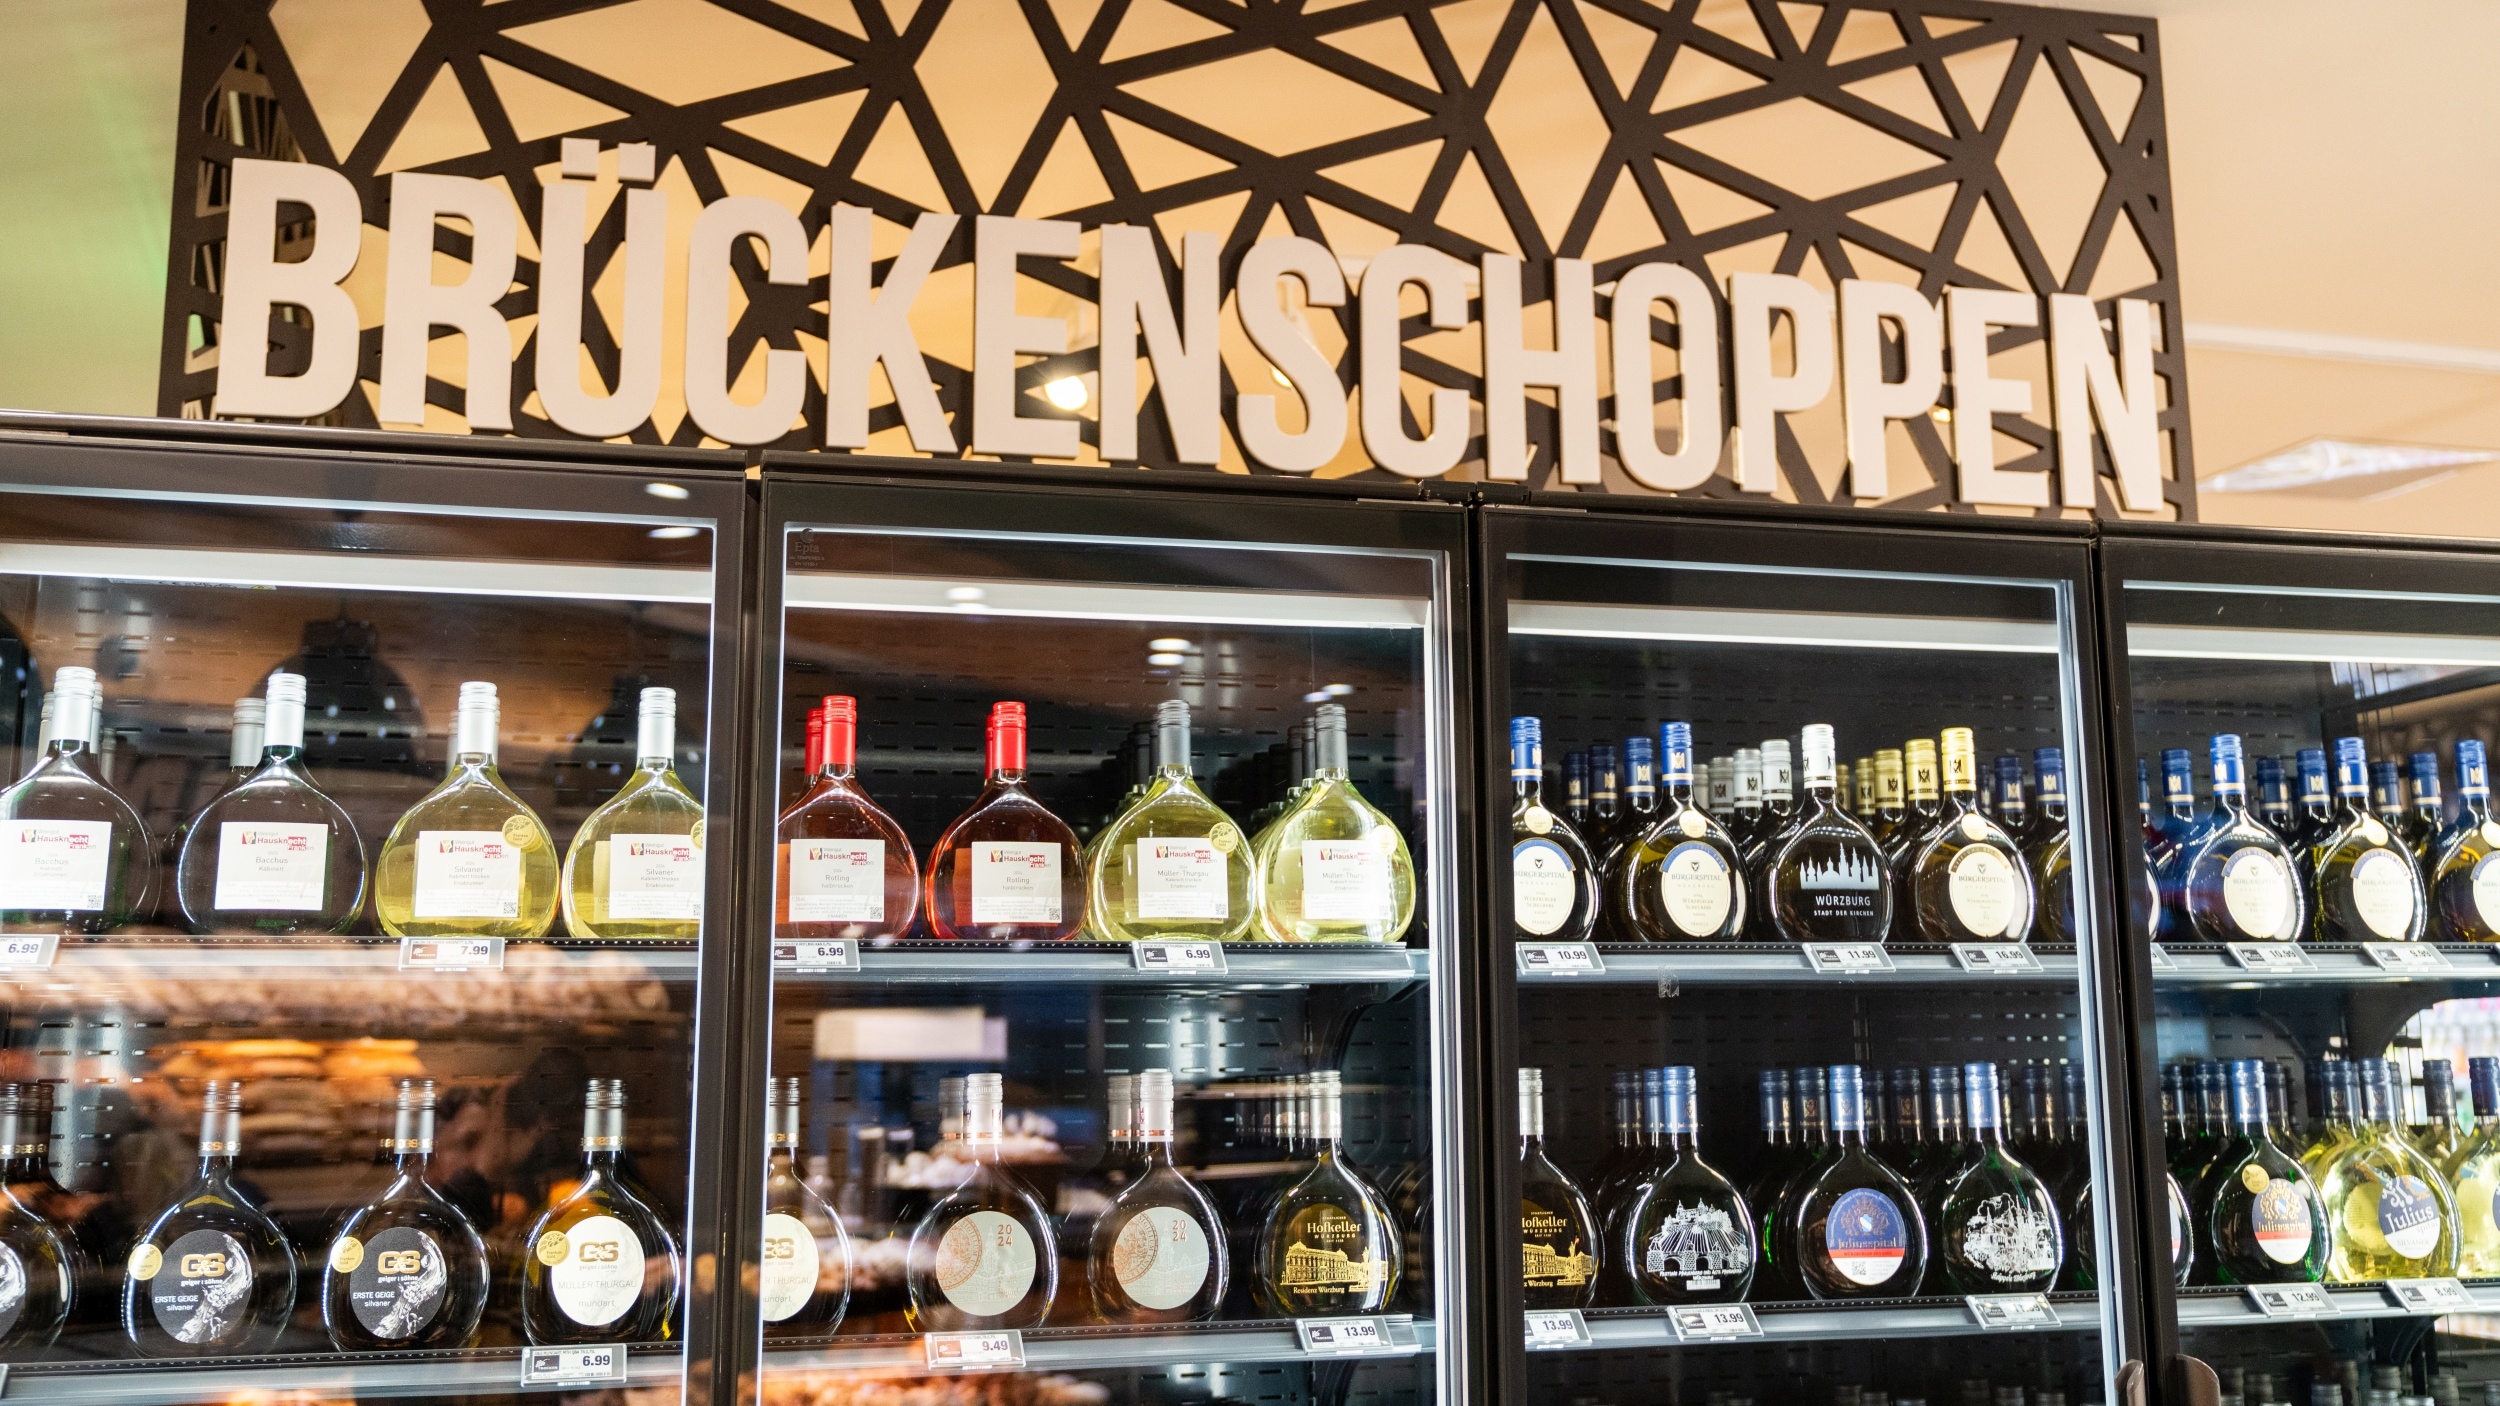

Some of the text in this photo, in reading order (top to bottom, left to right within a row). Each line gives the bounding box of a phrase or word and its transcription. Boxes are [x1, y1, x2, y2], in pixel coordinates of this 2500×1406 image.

[214, 137, 2165, 513] BRÜCKENSCHOPPEN
[36, 834, 89, 843] Hausknecht
[257, 836, 306, 844] Hausknecht
[454, 845, 502, 853] Hausknecht
[645, 848, 690, 856] Hausknecht
[1169, 850, 1210, 858] Hausknecht
[824, 852, 868, 860] Hausknecht
[1672, 873, 1722, 881] BÜRGERSPITAL
[1815, 894, 1871, 907] WÜRZBURG
[8, 943, 39, 954] 6.99
[461, 946, 488, 955] 7.99
[818, 946, 844, 956] 6.99
[1186, 949, 1210, 959] 6.99
[1557, 950, 1588, 960] 10.99
[1848, 950, 1876, 959] 11.99
[1995, 950, 2024, 959] 16.99
[2269, 950, 2297, 958] 10.99
[1172, 1219, 1188, 1230] 20
[2385, 1206, 2434, 1234] Julius
[997, 1224, 1013, 1235] 20
[1306, 1220, 1362, 1234] Hofkeller
[1172, 1230, 1188, 1242] 24
[997, 1236, 1013, 1247] 24
[2396, 1238, 2430, 1247] SILVANER
[578, 1240, 620, 1262] G&S
[181, 1253, 226, 1278] G&S
[378, 1250, 420, 1274] G&S
[1528, 1279, 1554, 1287] Würzburg
[1318, 1286, 1345, 1294] Würzburg
[2292, 1292, 2320, 1302] 12.99
[578, 1299, 616, 1307] mundart
[1714, 1312, 1744, 1323] 13.99
[1542, 1320, 1574, 1331] 13.99
[1344, 1326, 1376, 1337] 13.99
[982, 1340, 1008, 1351] 9.49
[582, 1354, 610, 1367] 6.99
